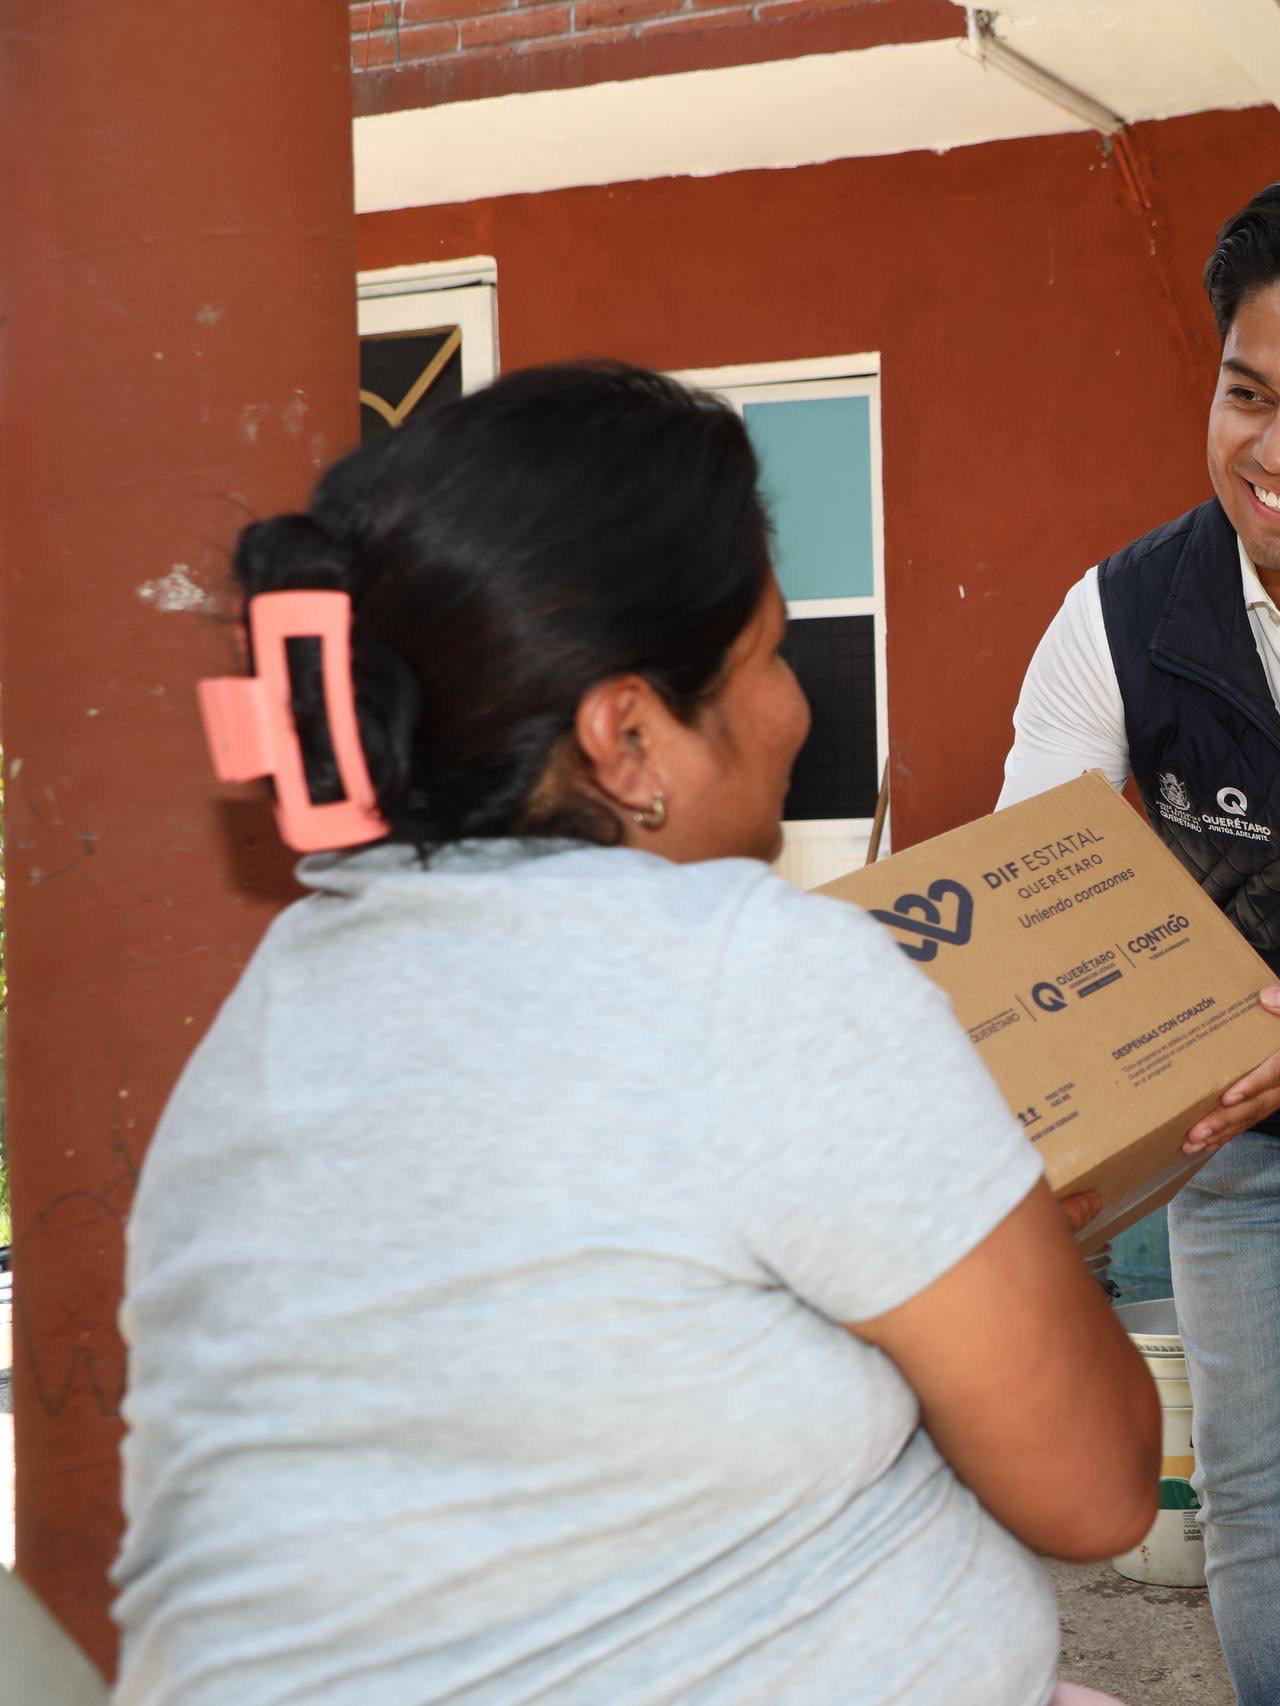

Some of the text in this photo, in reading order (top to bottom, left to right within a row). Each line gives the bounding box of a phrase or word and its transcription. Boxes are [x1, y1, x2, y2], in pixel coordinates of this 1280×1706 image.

[1202, 814, 1271, 836] QUERÉTARO
[982, 828, 1104, 890] DIF ESTATAL
[1017, 854, 1103, 899] QUERÉTARO
[1018, 868, 1136, 929] Uniendo corazones
[1056, 950, 1116, 986] QUERÉTARO
[1112, 1029, 1160, 1060] DESPENSAS
[1158, 1018, 1178, 1034] CON
[1177, 997, 1216, 1023] CORAZÓN
